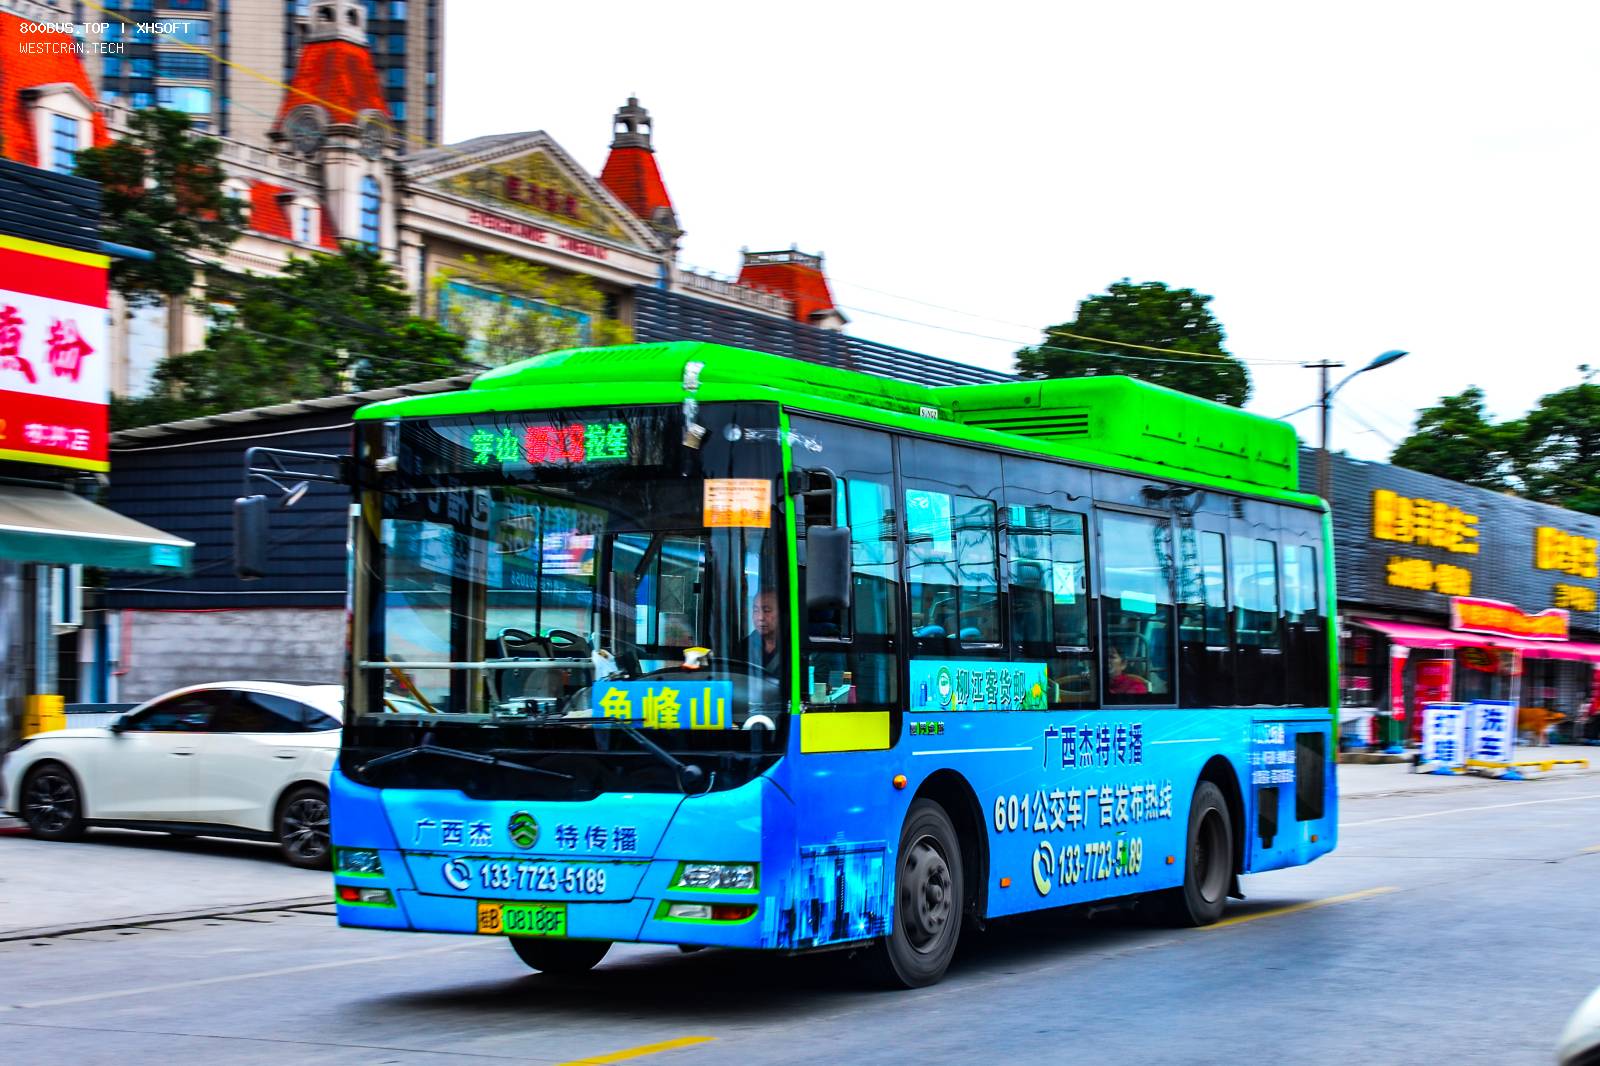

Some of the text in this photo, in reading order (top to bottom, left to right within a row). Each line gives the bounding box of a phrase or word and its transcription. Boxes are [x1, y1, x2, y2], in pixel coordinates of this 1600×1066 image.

[955, 668, 1026, 704] 柳江客货邮
[1043, 722, 1144, 770] 广西杰特传播
[994, 778, 1172, 832] 601公交车广告发布热线
[415, 818, 638, 853] 广西杰 特传播
[481, 863, 607, 894] 133-7723-5189
